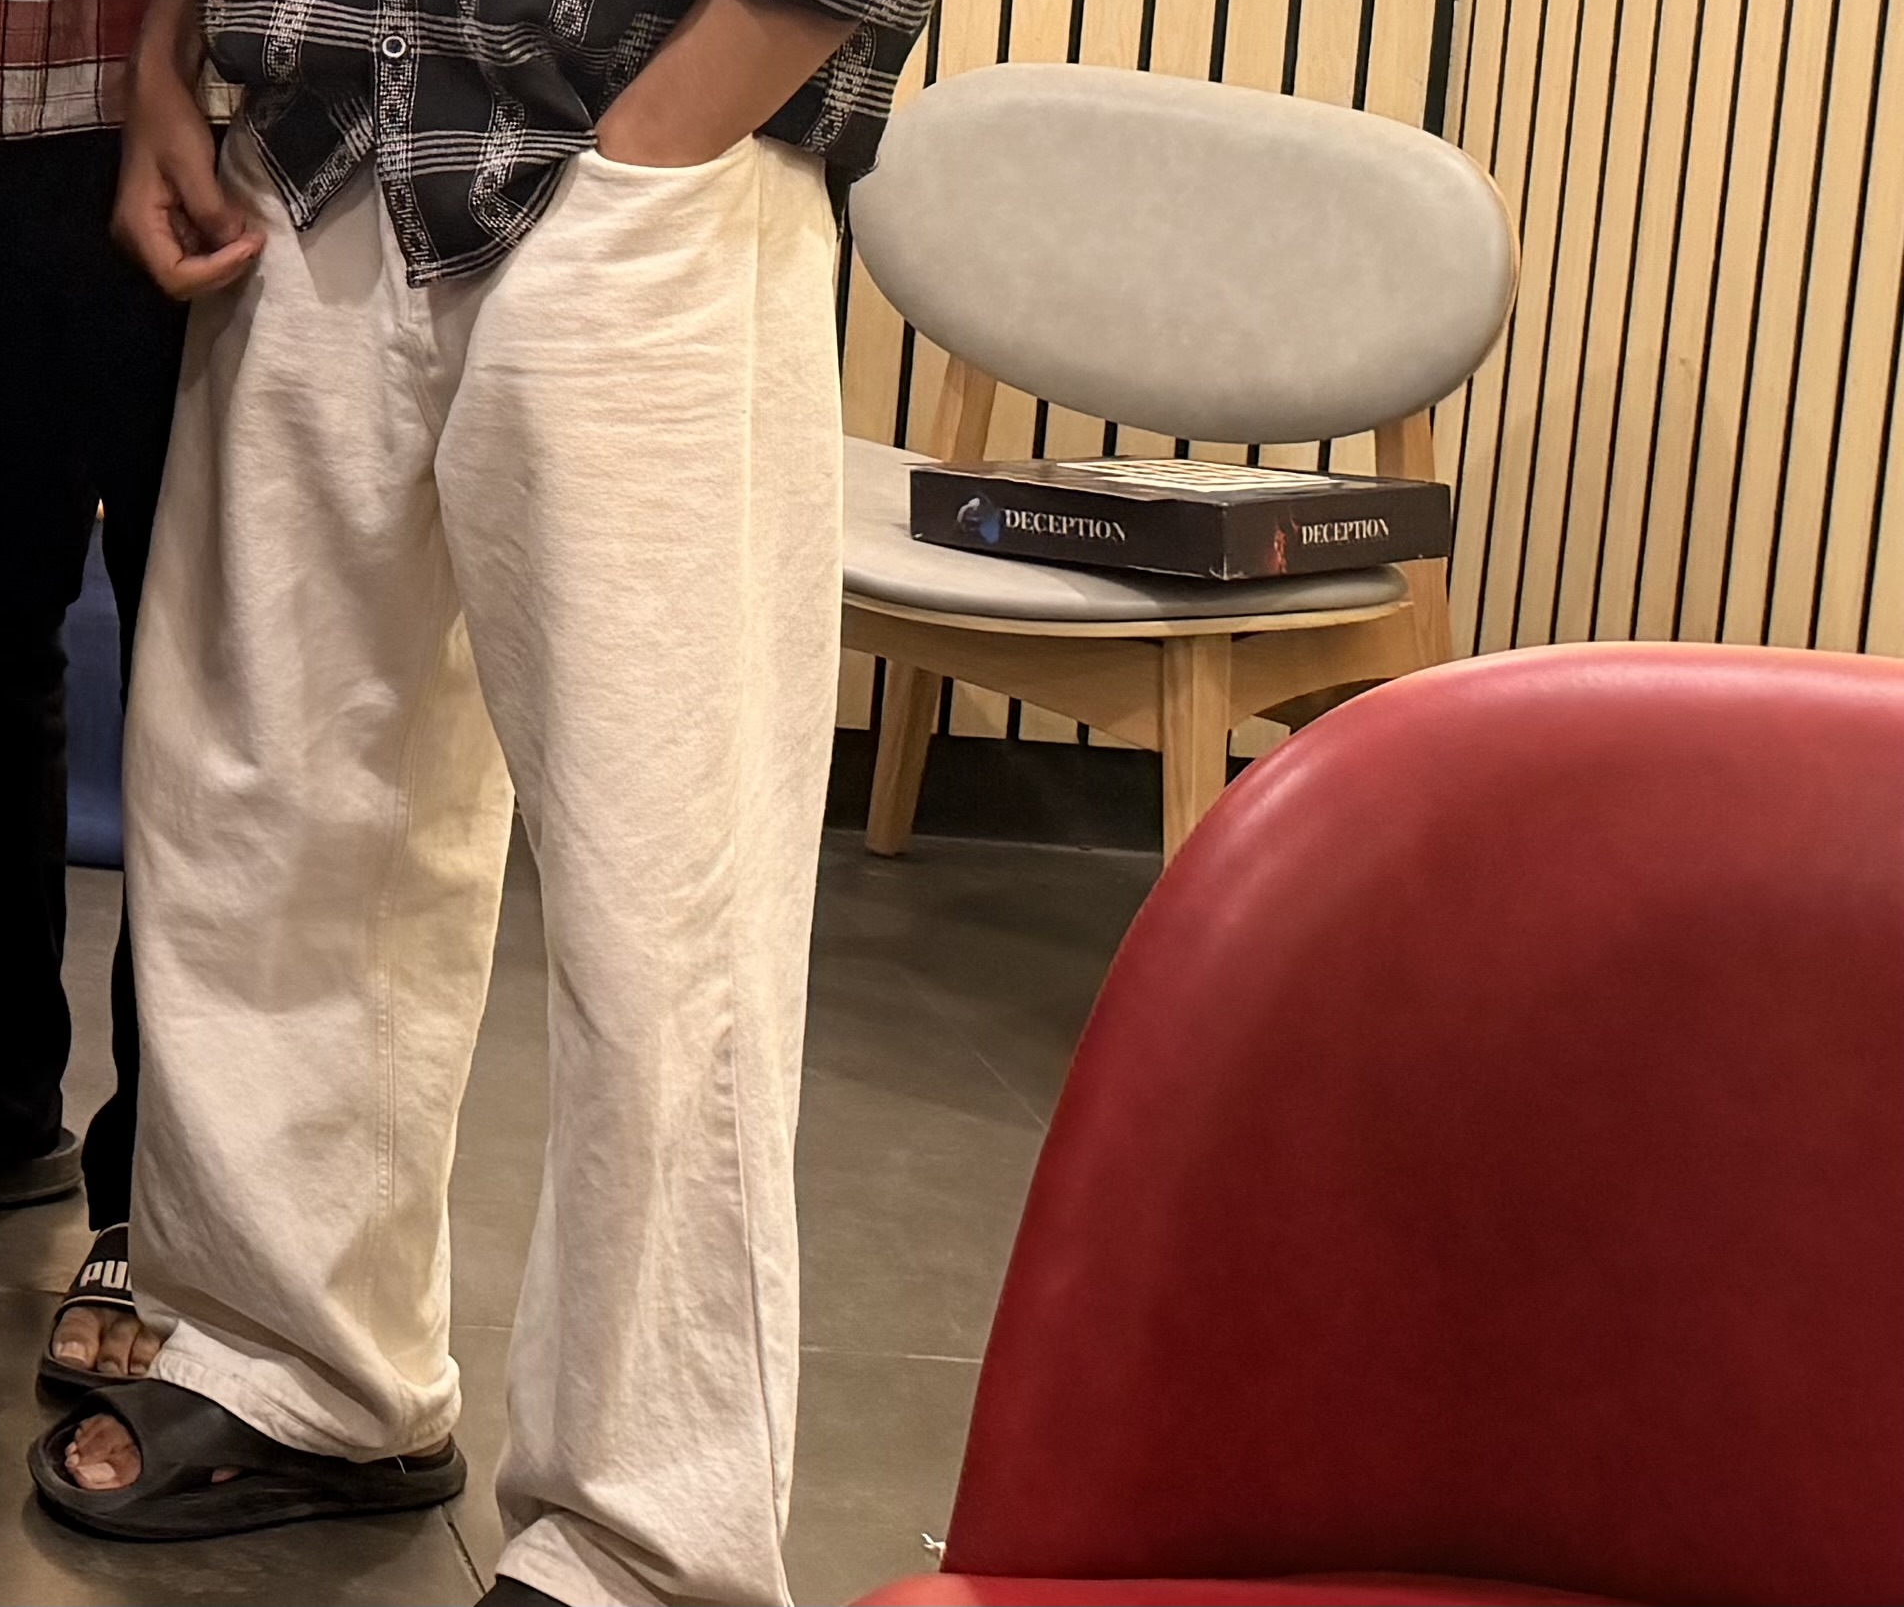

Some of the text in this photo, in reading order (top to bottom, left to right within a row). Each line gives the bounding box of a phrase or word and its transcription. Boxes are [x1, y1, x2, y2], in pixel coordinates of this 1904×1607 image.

[1004, 508, 1126, 541] DECEPTION
[1301, 518, 1390, 545] DECEPTION
[79, 1260, 132, 1291] PU
